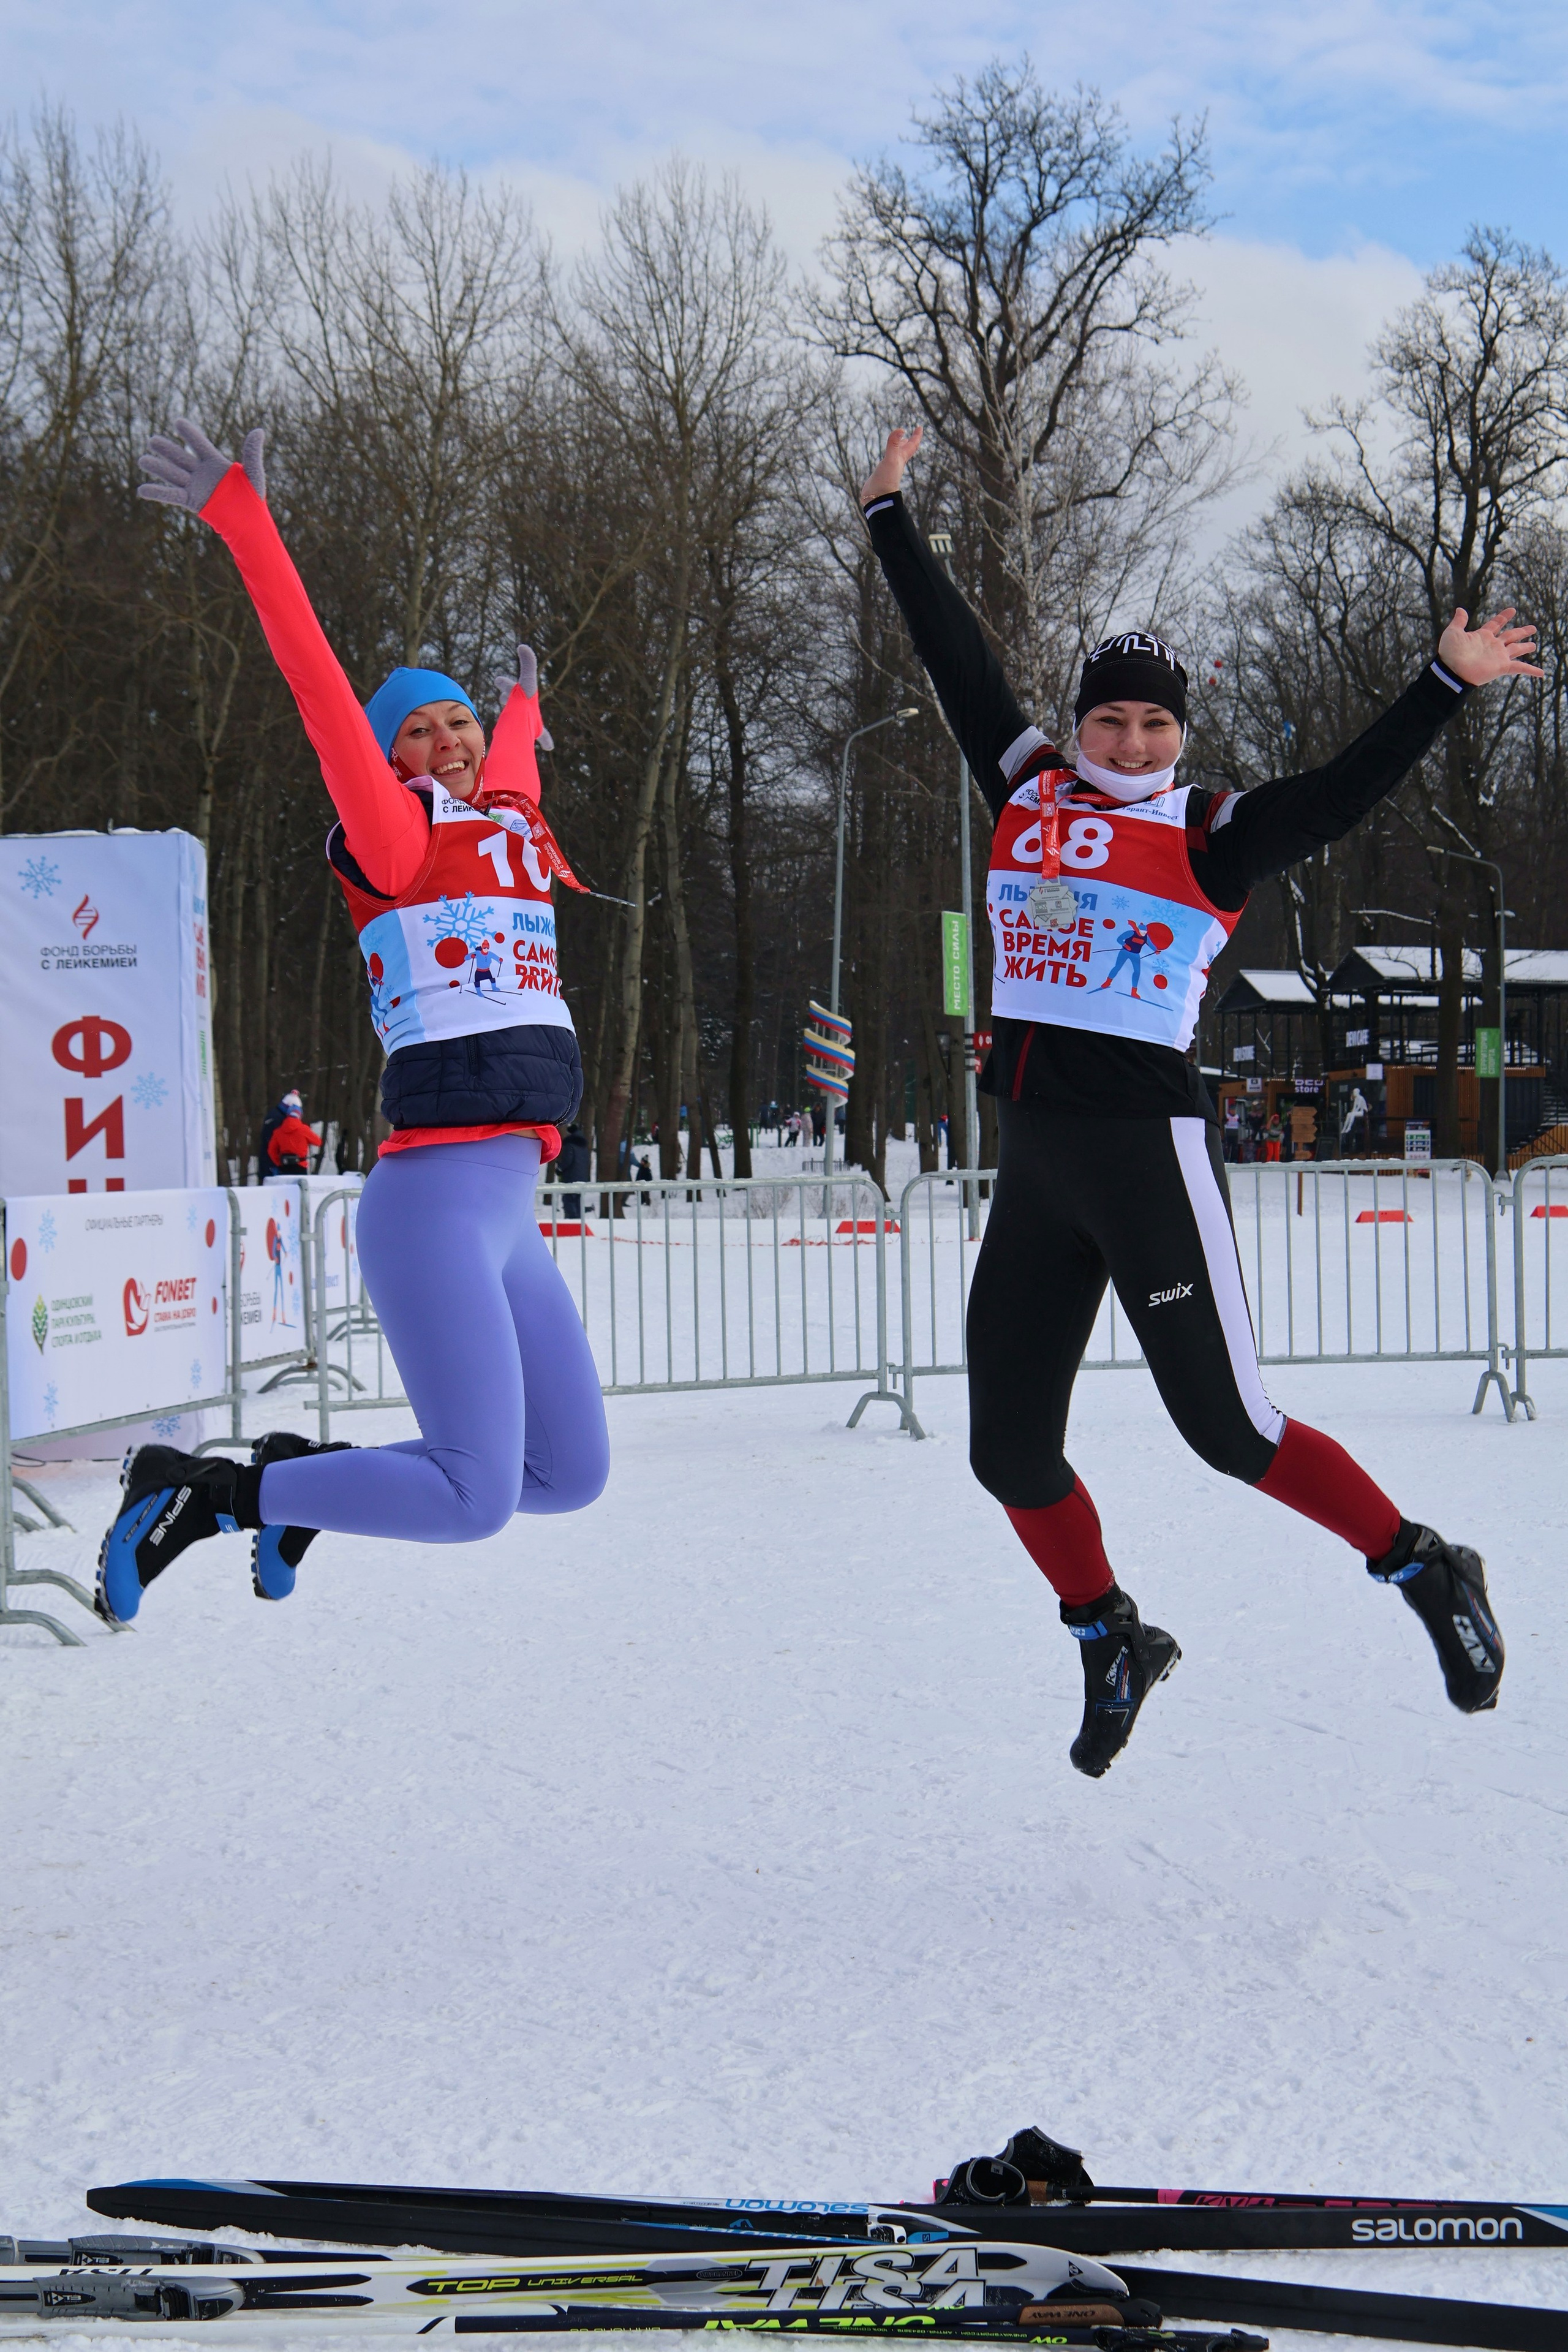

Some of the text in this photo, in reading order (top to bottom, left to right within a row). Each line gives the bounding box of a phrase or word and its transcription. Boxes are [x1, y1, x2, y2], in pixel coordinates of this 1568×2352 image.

[1011, 817, 1114, 869] 68
[40, 944, 137, 957] ФОНД БОРЬБЫ
[1003, 932, 1091, 963] ВРЕМЯ
[41, 959, 50, 970] С
[1004, 956, 1088, 987] ЖИТЬ
[154, 1277, 197, 1304] FONBET
[149, 1485, 192, 1547] SPINE
[725, 2198, 870, 2213] salomon
[1351, 2217, 1523, 2241] salomon
[748, 2247, 979, 2290] TISA
[428, 2274, 644, 2293] TOP UNIVERSAL
